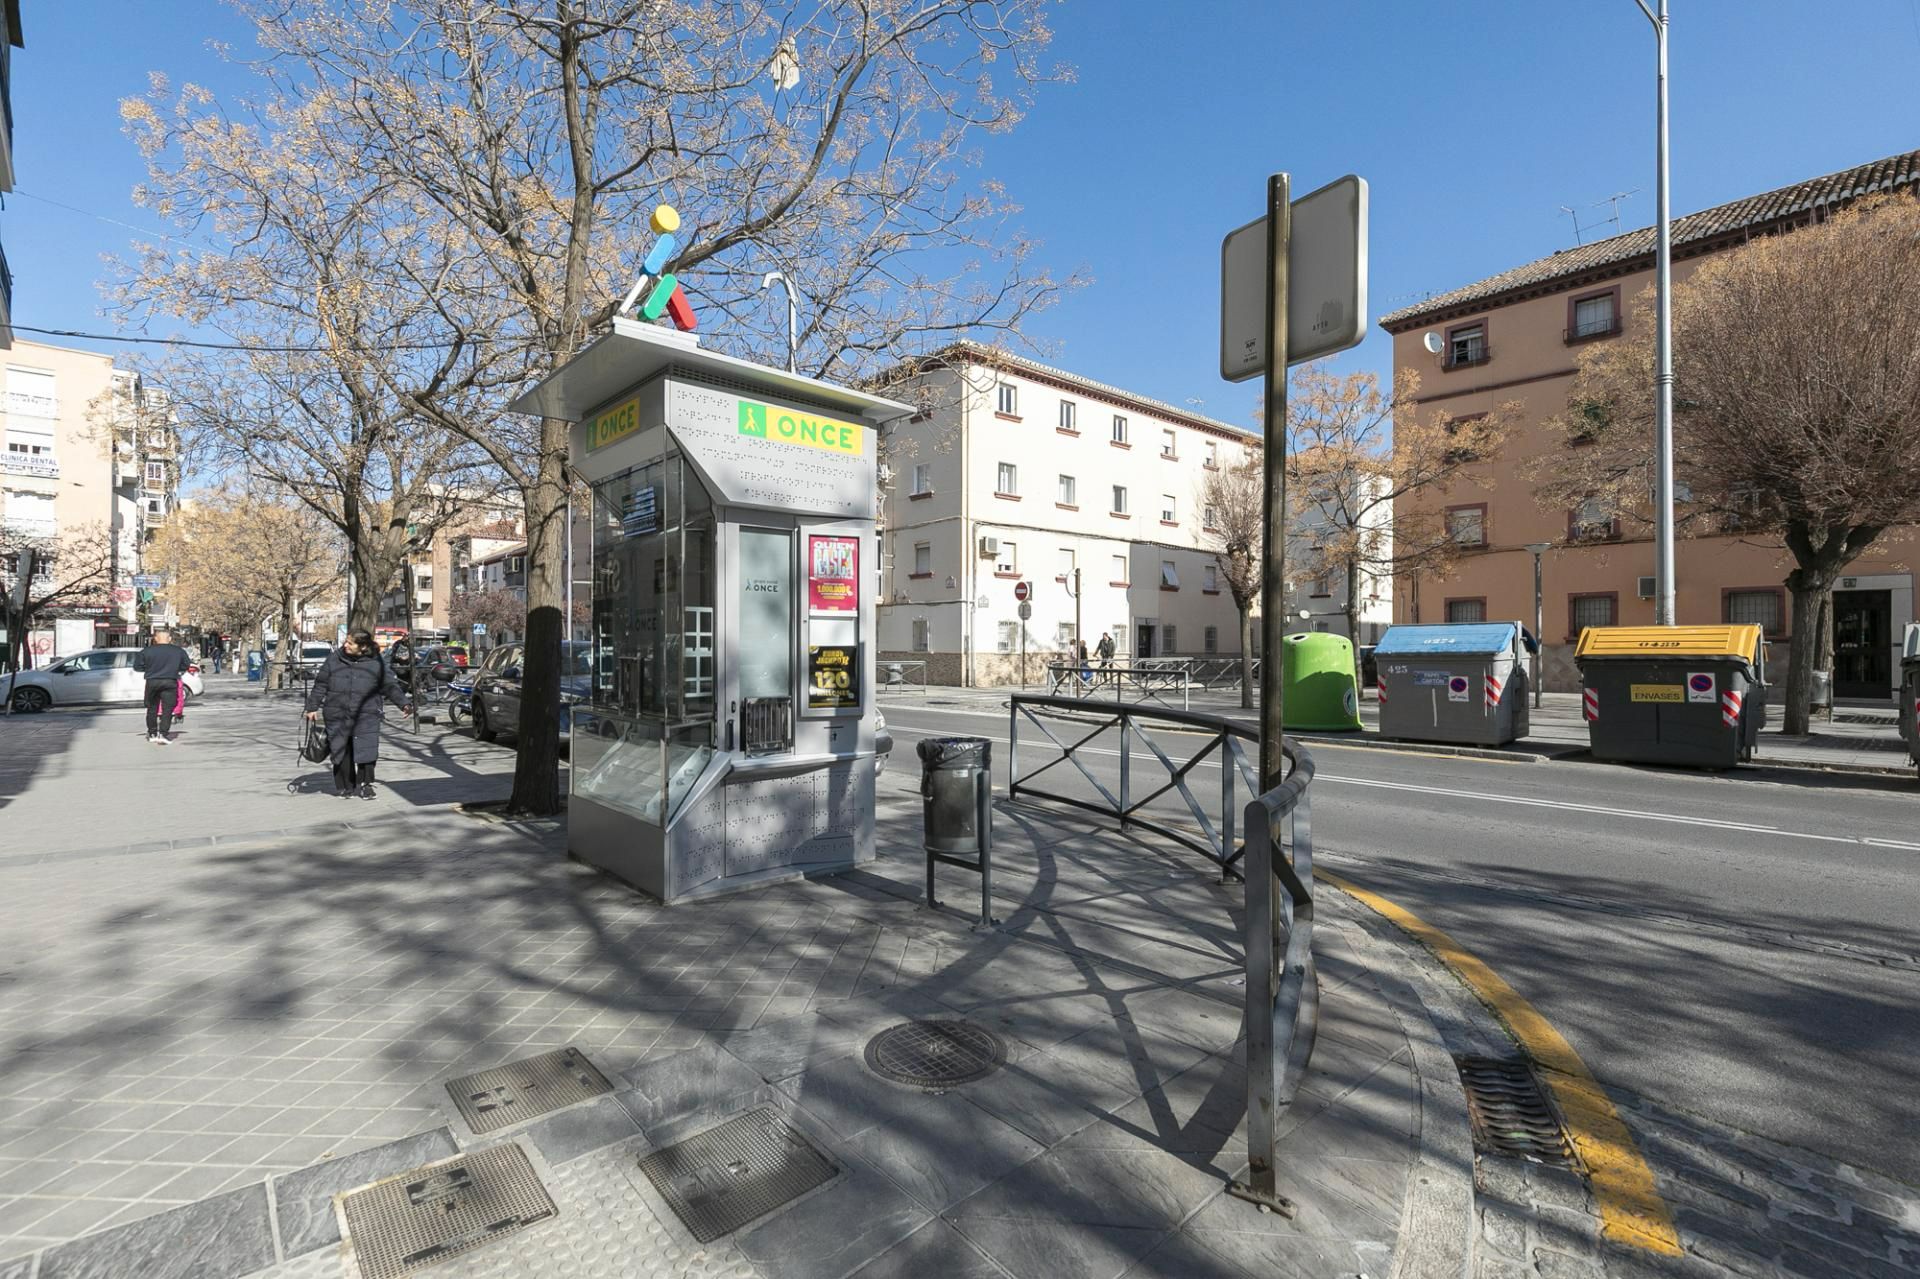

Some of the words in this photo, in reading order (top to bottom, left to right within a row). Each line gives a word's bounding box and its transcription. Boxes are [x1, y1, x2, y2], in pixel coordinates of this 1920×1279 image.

[601, 405, 635, 442] ONCE
[777, 415, 854, 449] ONCE
[814, 541, 855, 550] QUIEN
[753, 584, 778, 593] ONCE
[815, 671, 850, 689] 120
[1635, 692, 1681, 701] ENVASES
